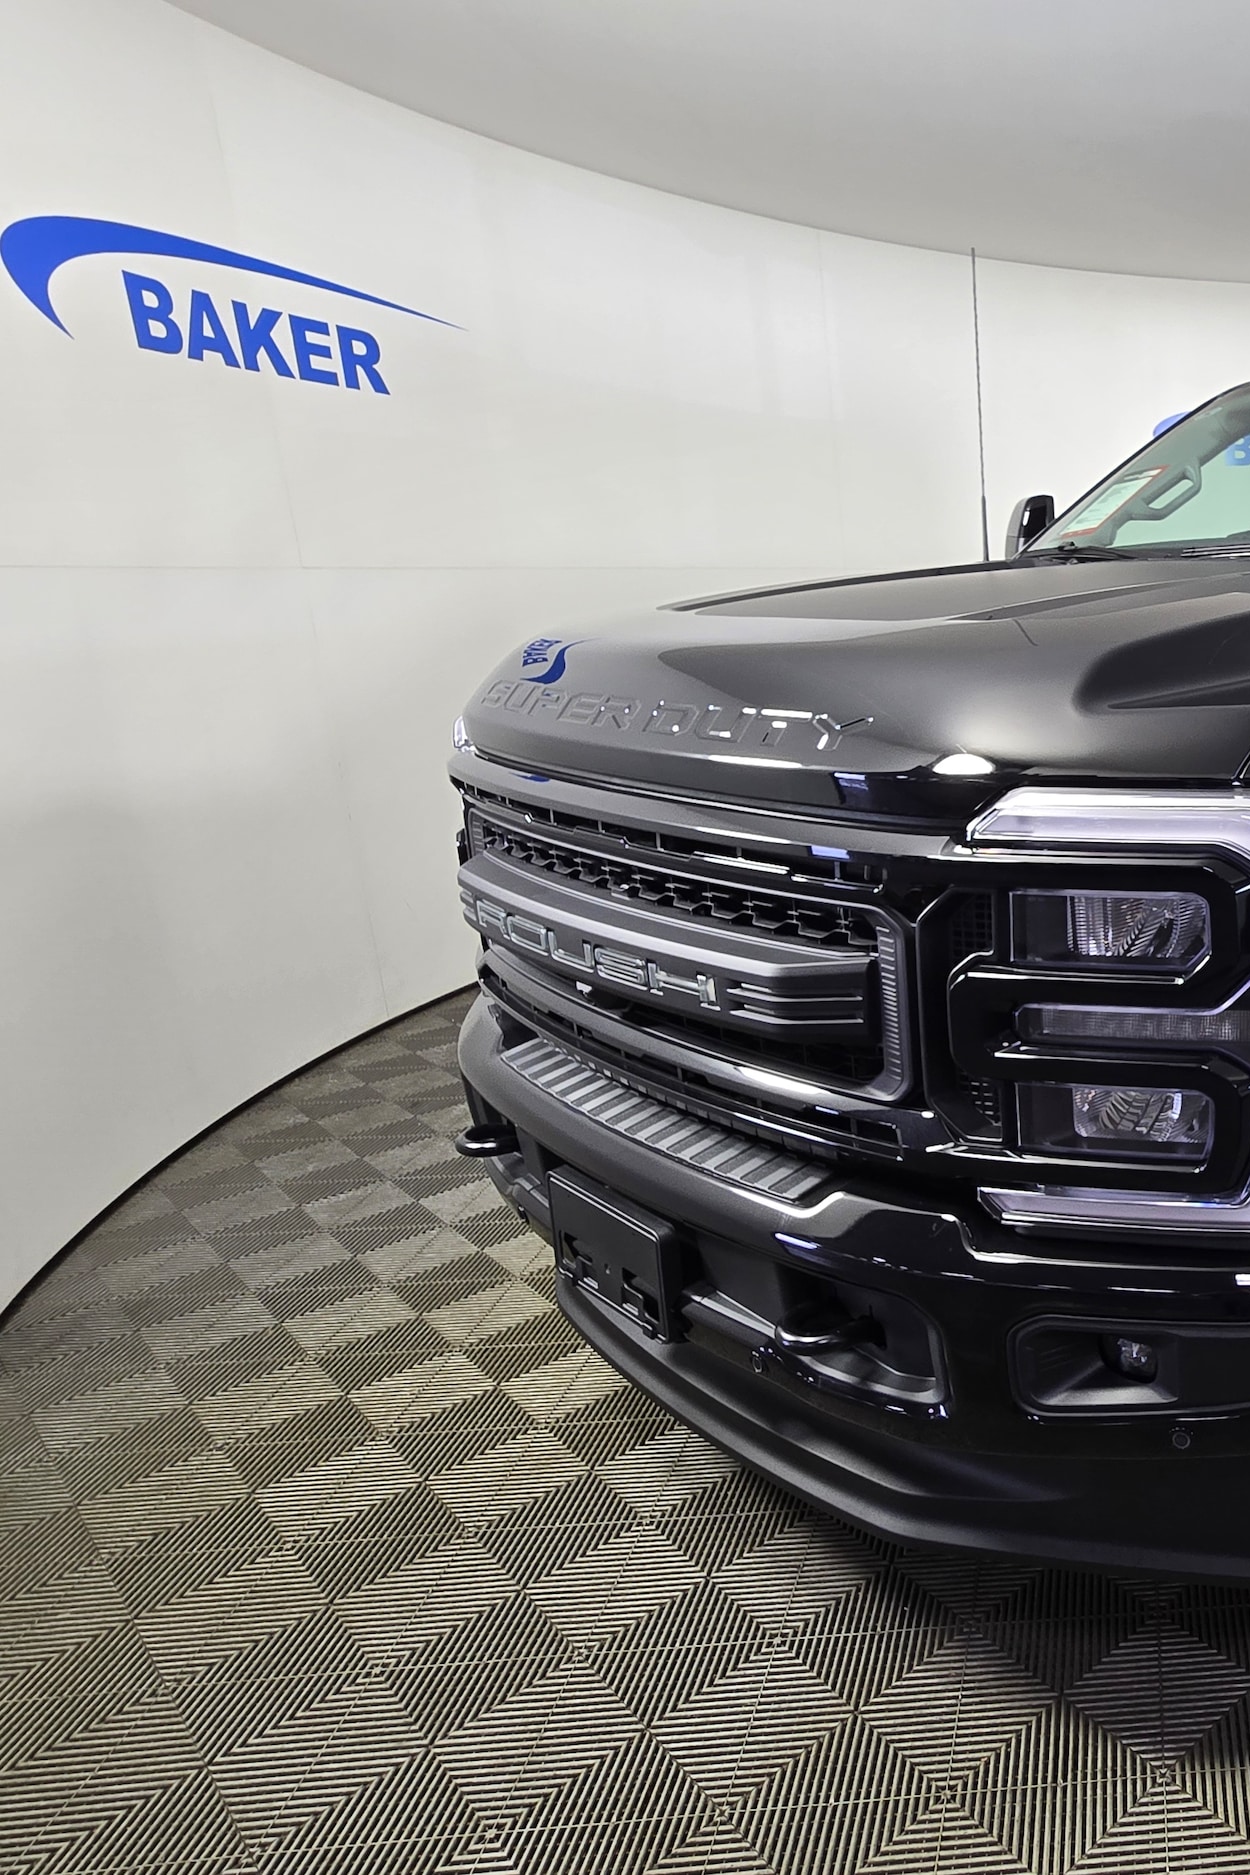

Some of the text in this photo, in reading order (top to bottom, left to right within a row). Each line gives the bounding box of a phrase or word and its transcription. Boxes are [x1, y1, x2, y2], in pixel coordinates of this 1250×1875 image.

[121, 269, 391, 396] BAKER
[481, 680, 876, 751] SUPER DUTY
[475, 899, 722, 1012] ROUSH
